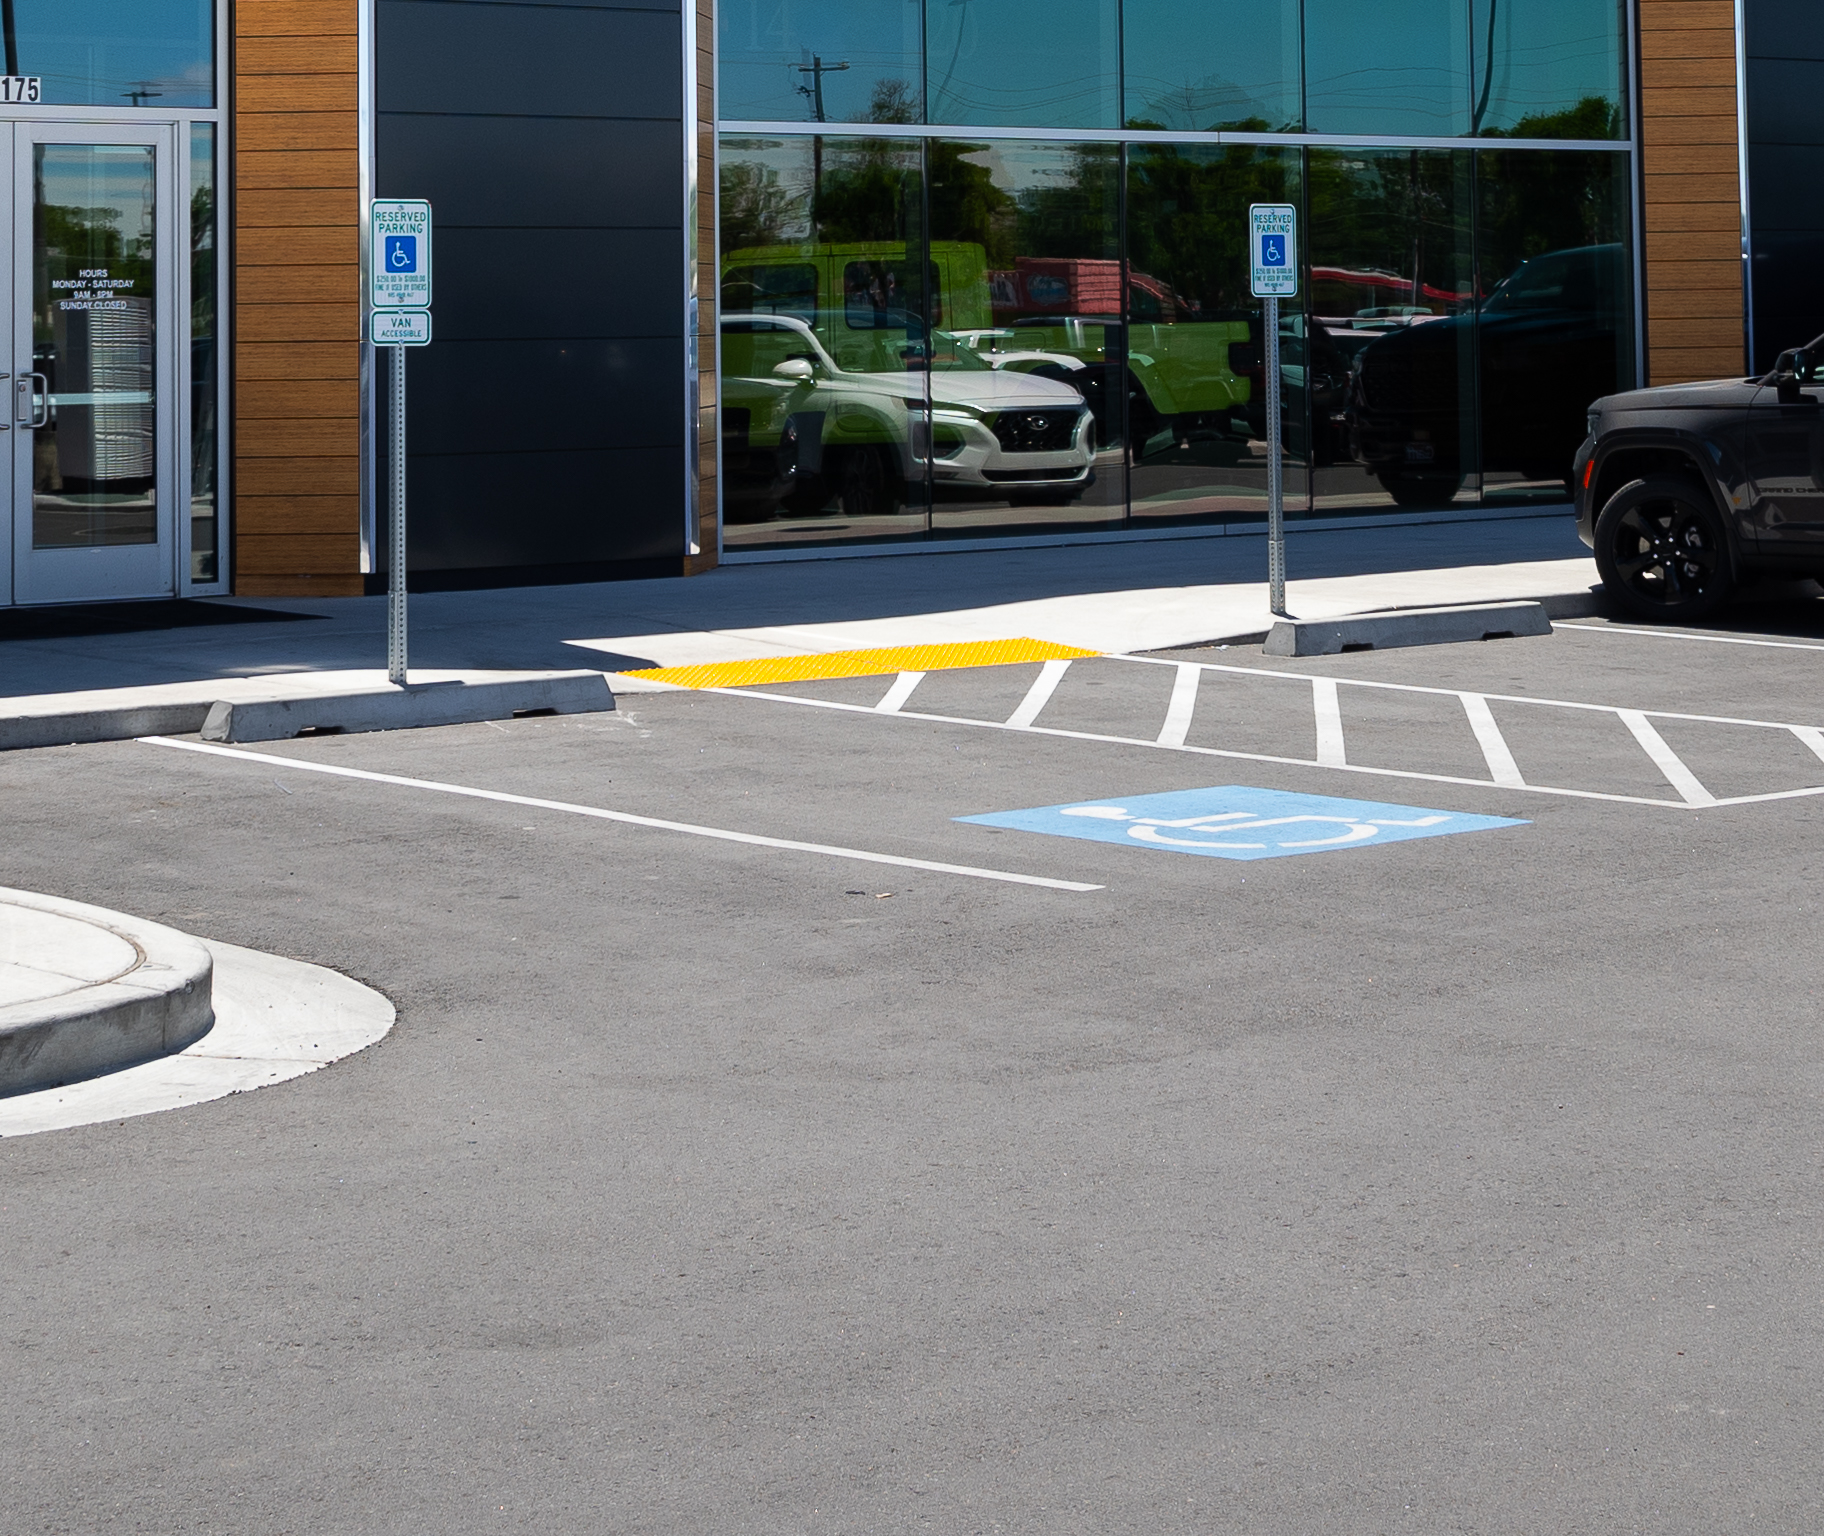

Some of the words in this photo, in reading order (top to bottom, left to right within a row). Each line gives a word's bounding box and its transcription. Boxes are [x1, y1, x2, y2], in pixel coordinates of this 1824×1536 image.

[375, 211, 426, 222] RESERVED
[1254, 214, 1292, 224] RESERVED
[378, 223, 423, 233] PARKING
[1257, 224, 1290, 233] PARKING
[79, 269, 108, 278] HOURS
[52, 280, 87, 288] MONDAY
[92, 279, 135, 288] SATURDAY
[60, 301, 92, 310] SUNDAY
[93, 300, 127, 310] CLOSED
[390, 317, 412, 328] VAN
[381, 329, 422, 338] ACCESSIBLE
